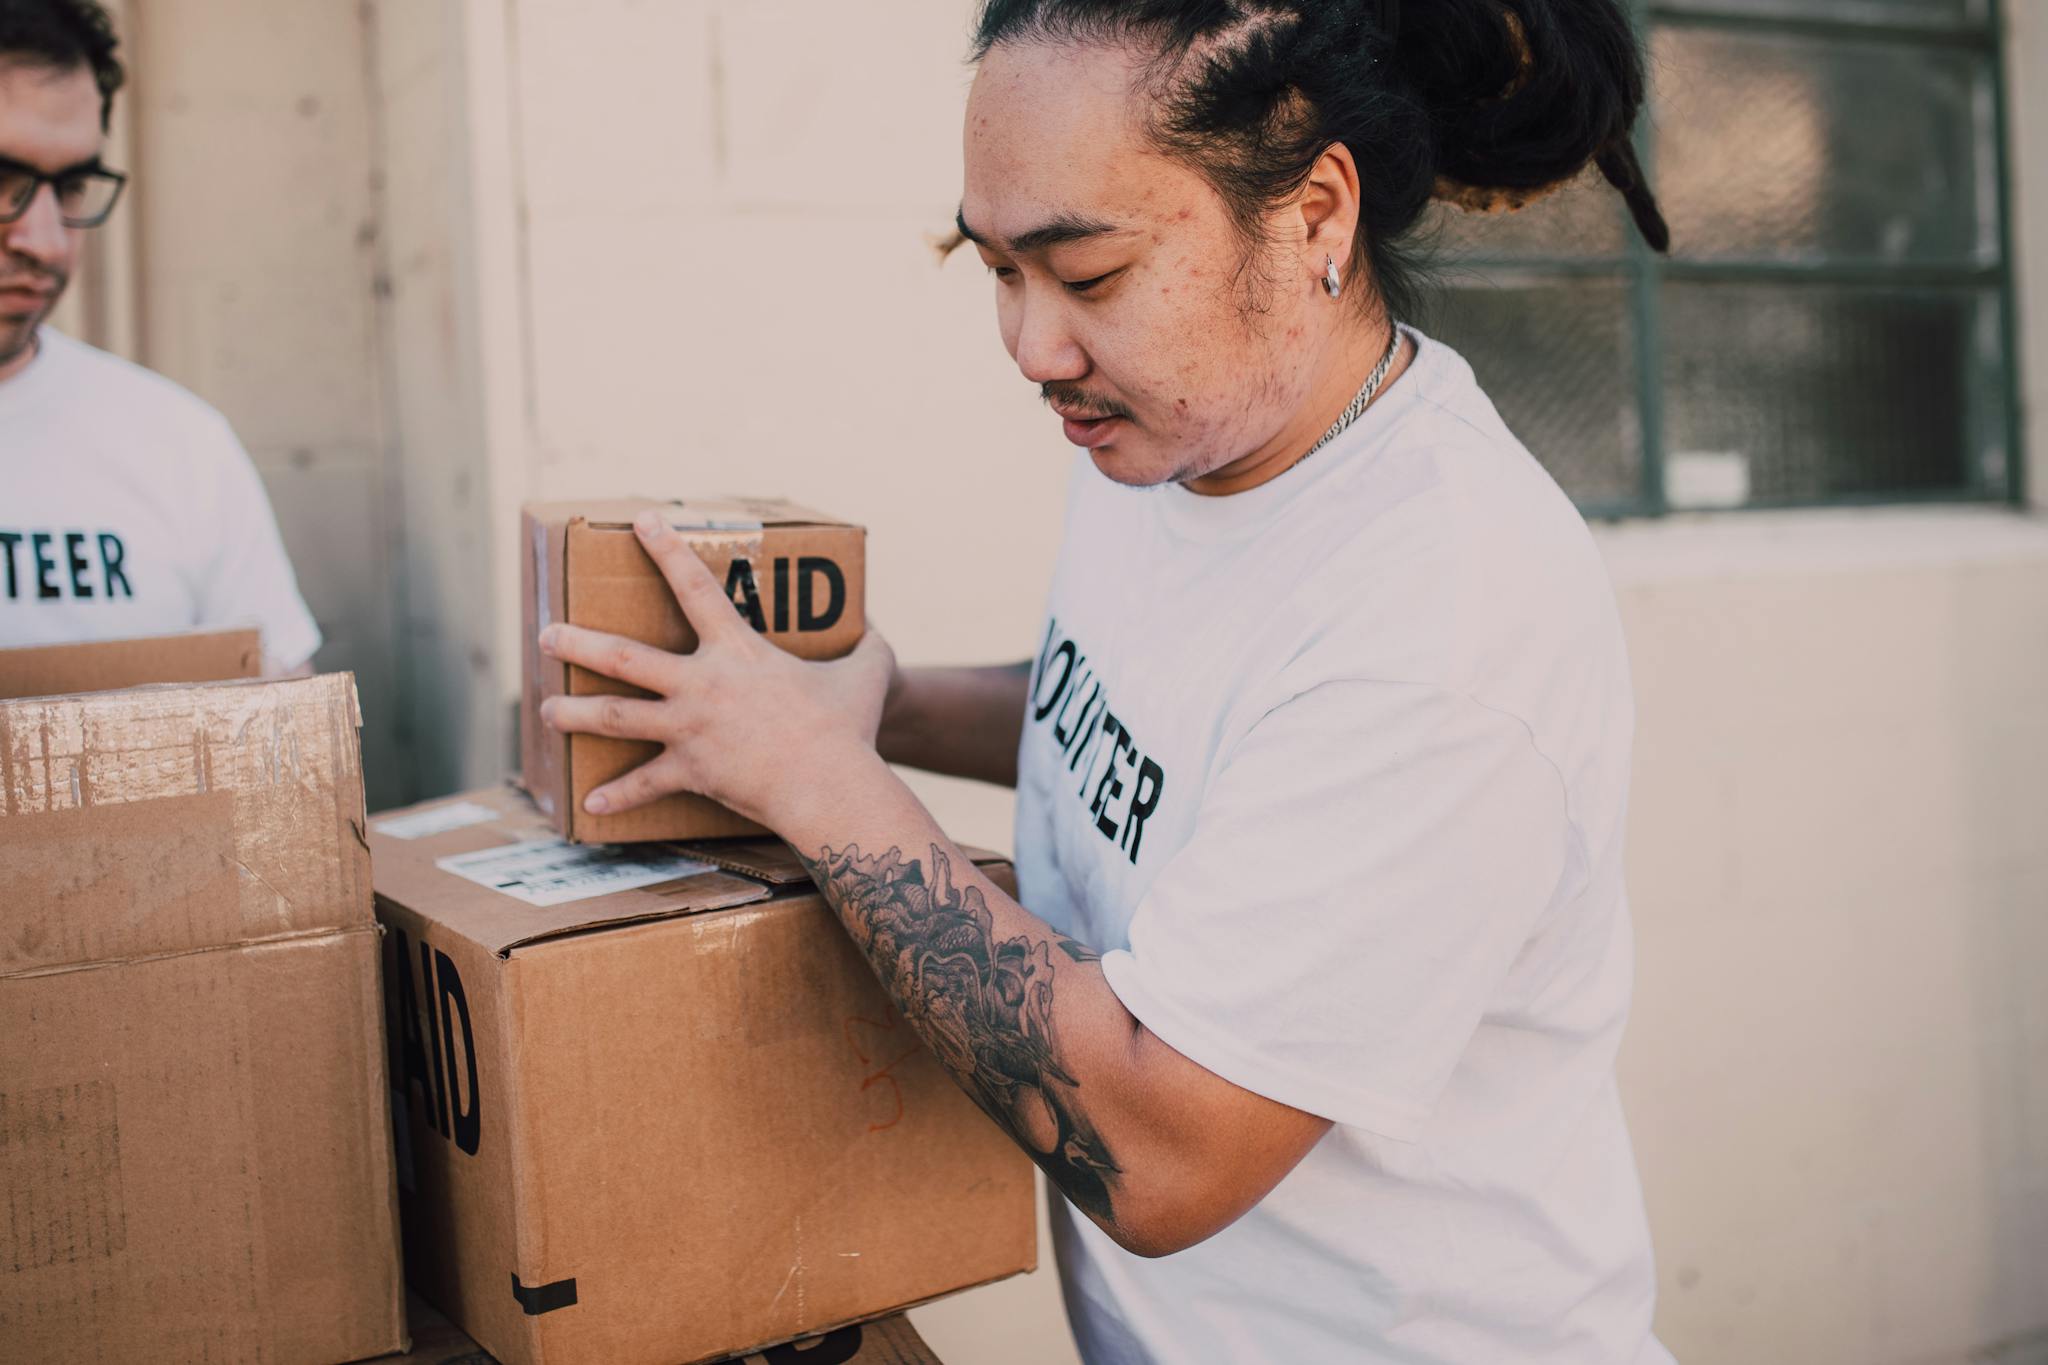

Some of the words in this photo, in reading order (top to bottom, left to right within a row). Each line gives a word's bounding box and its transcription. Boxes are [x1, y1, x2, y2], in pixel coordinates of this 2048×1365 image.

[725, 556, 846, 632] AID
[1033, 617, 1164, 865] VOLUNTER
[397, 926, 481, 1156] AID
